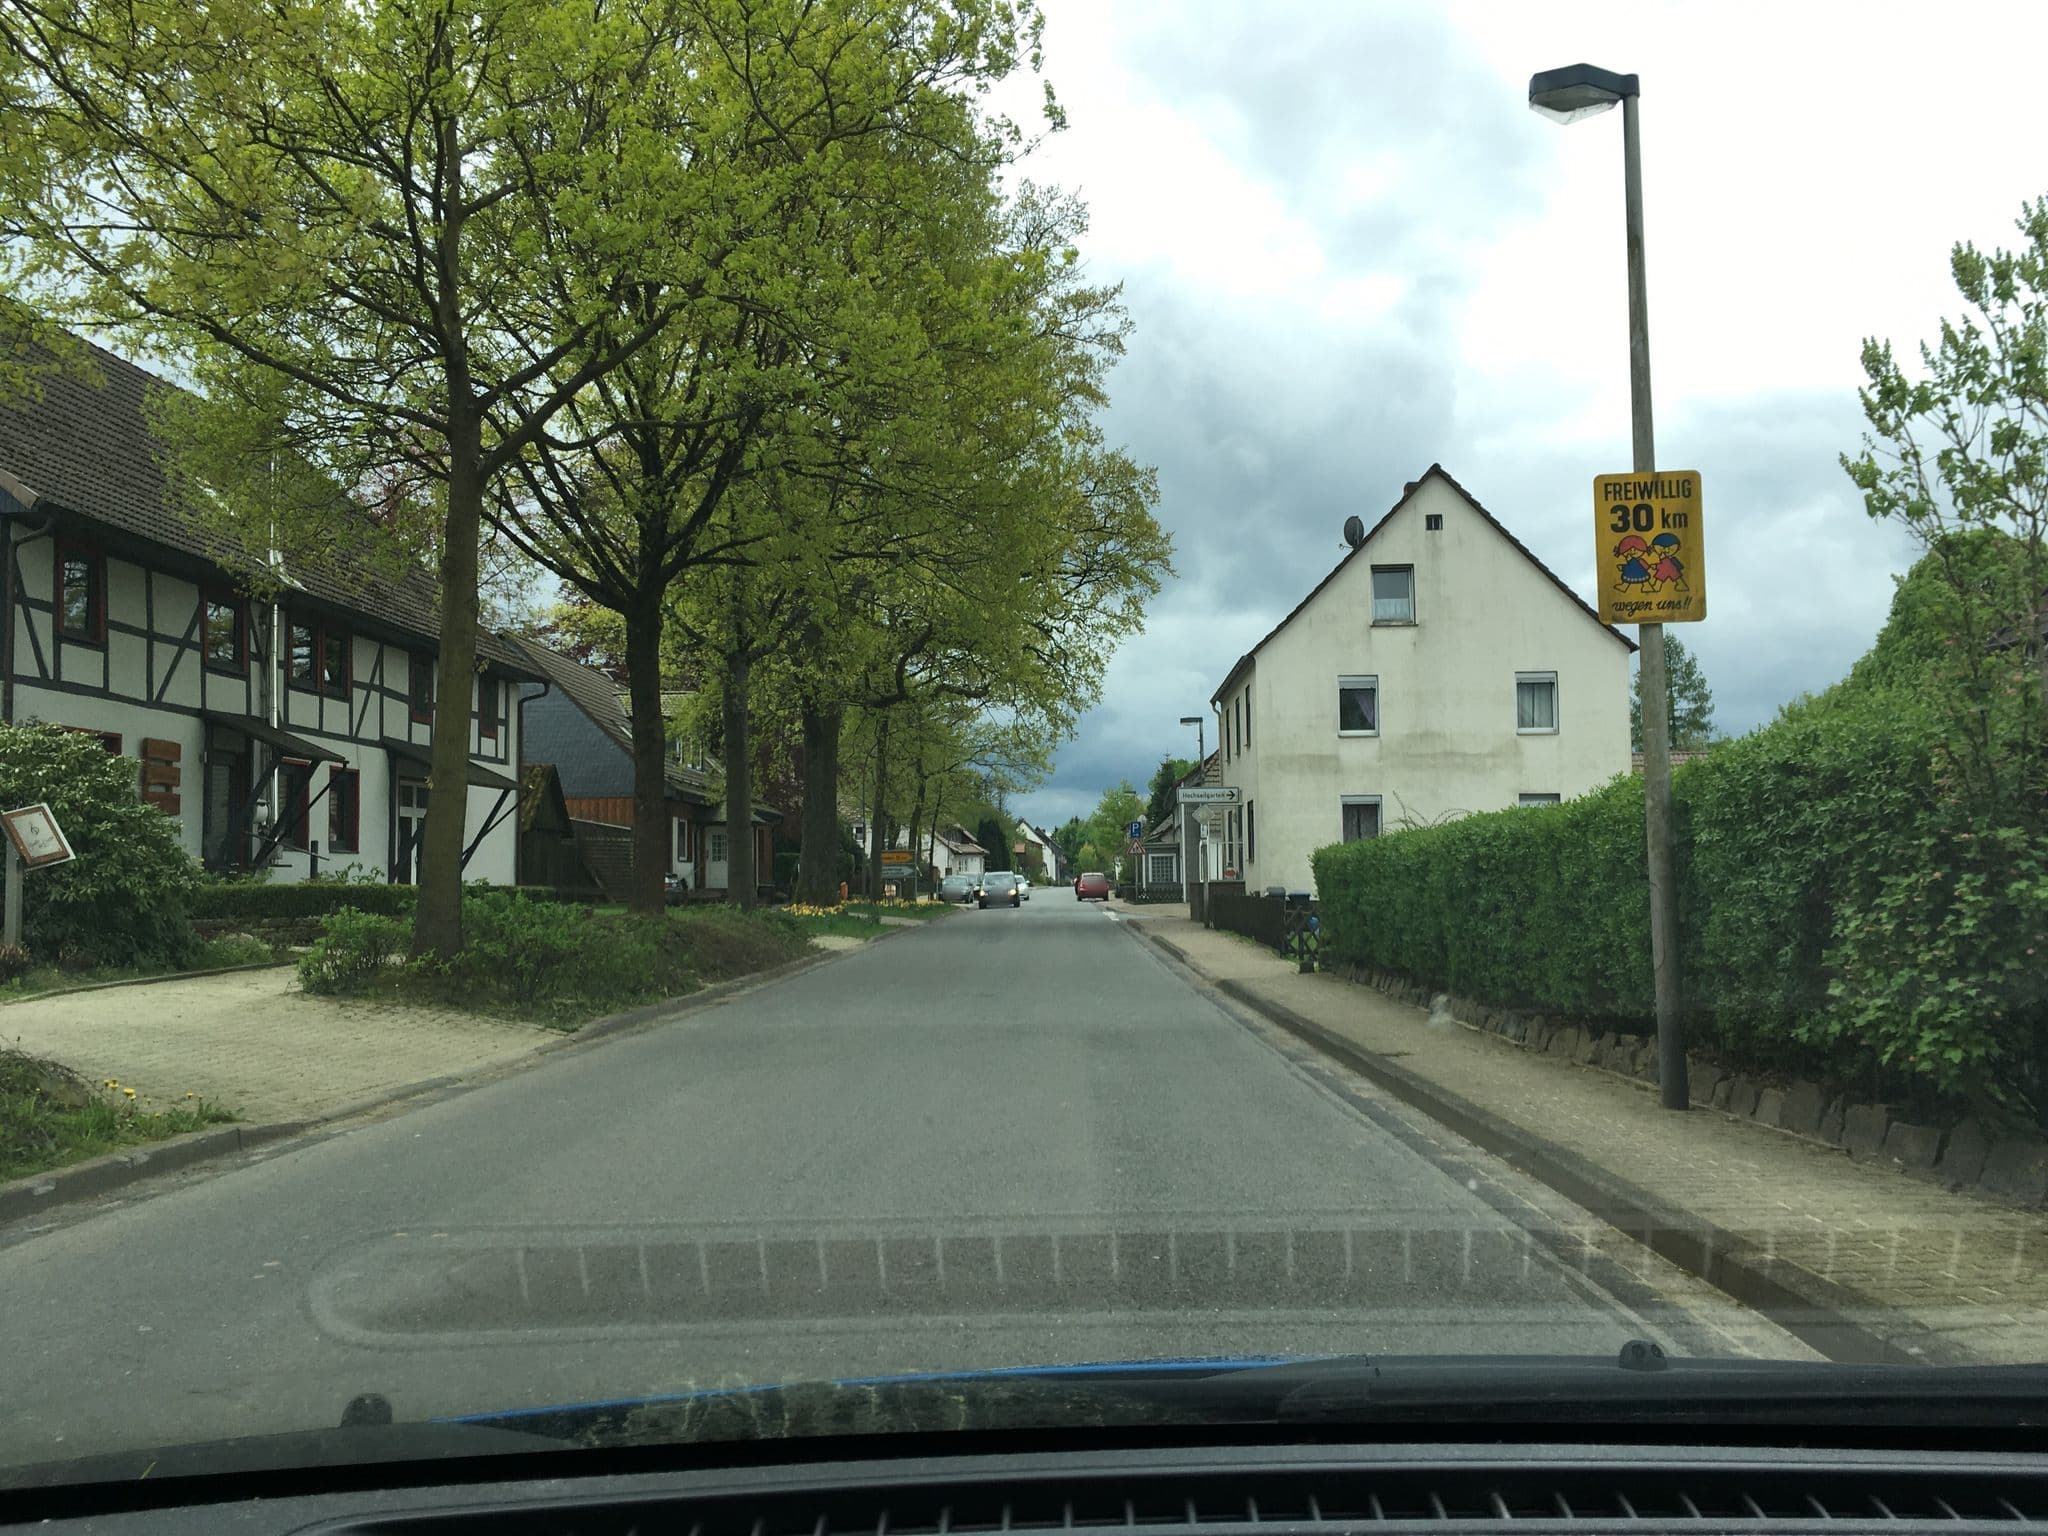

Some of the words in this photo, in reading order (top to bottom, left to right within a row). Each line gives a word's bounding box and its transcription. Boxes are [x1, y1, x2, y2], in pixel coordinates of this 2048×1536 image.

[1604, 480, 1691, 501] FREIWILLIG
[1610, 504, 1654, 533] 30
[1661, 508, 1688, 529] km
[1612, 600, 1654, 616] wegen
[1182, 791, 1225, 799] Hochseilgarten
[1132, 823, 1139, 832] P
